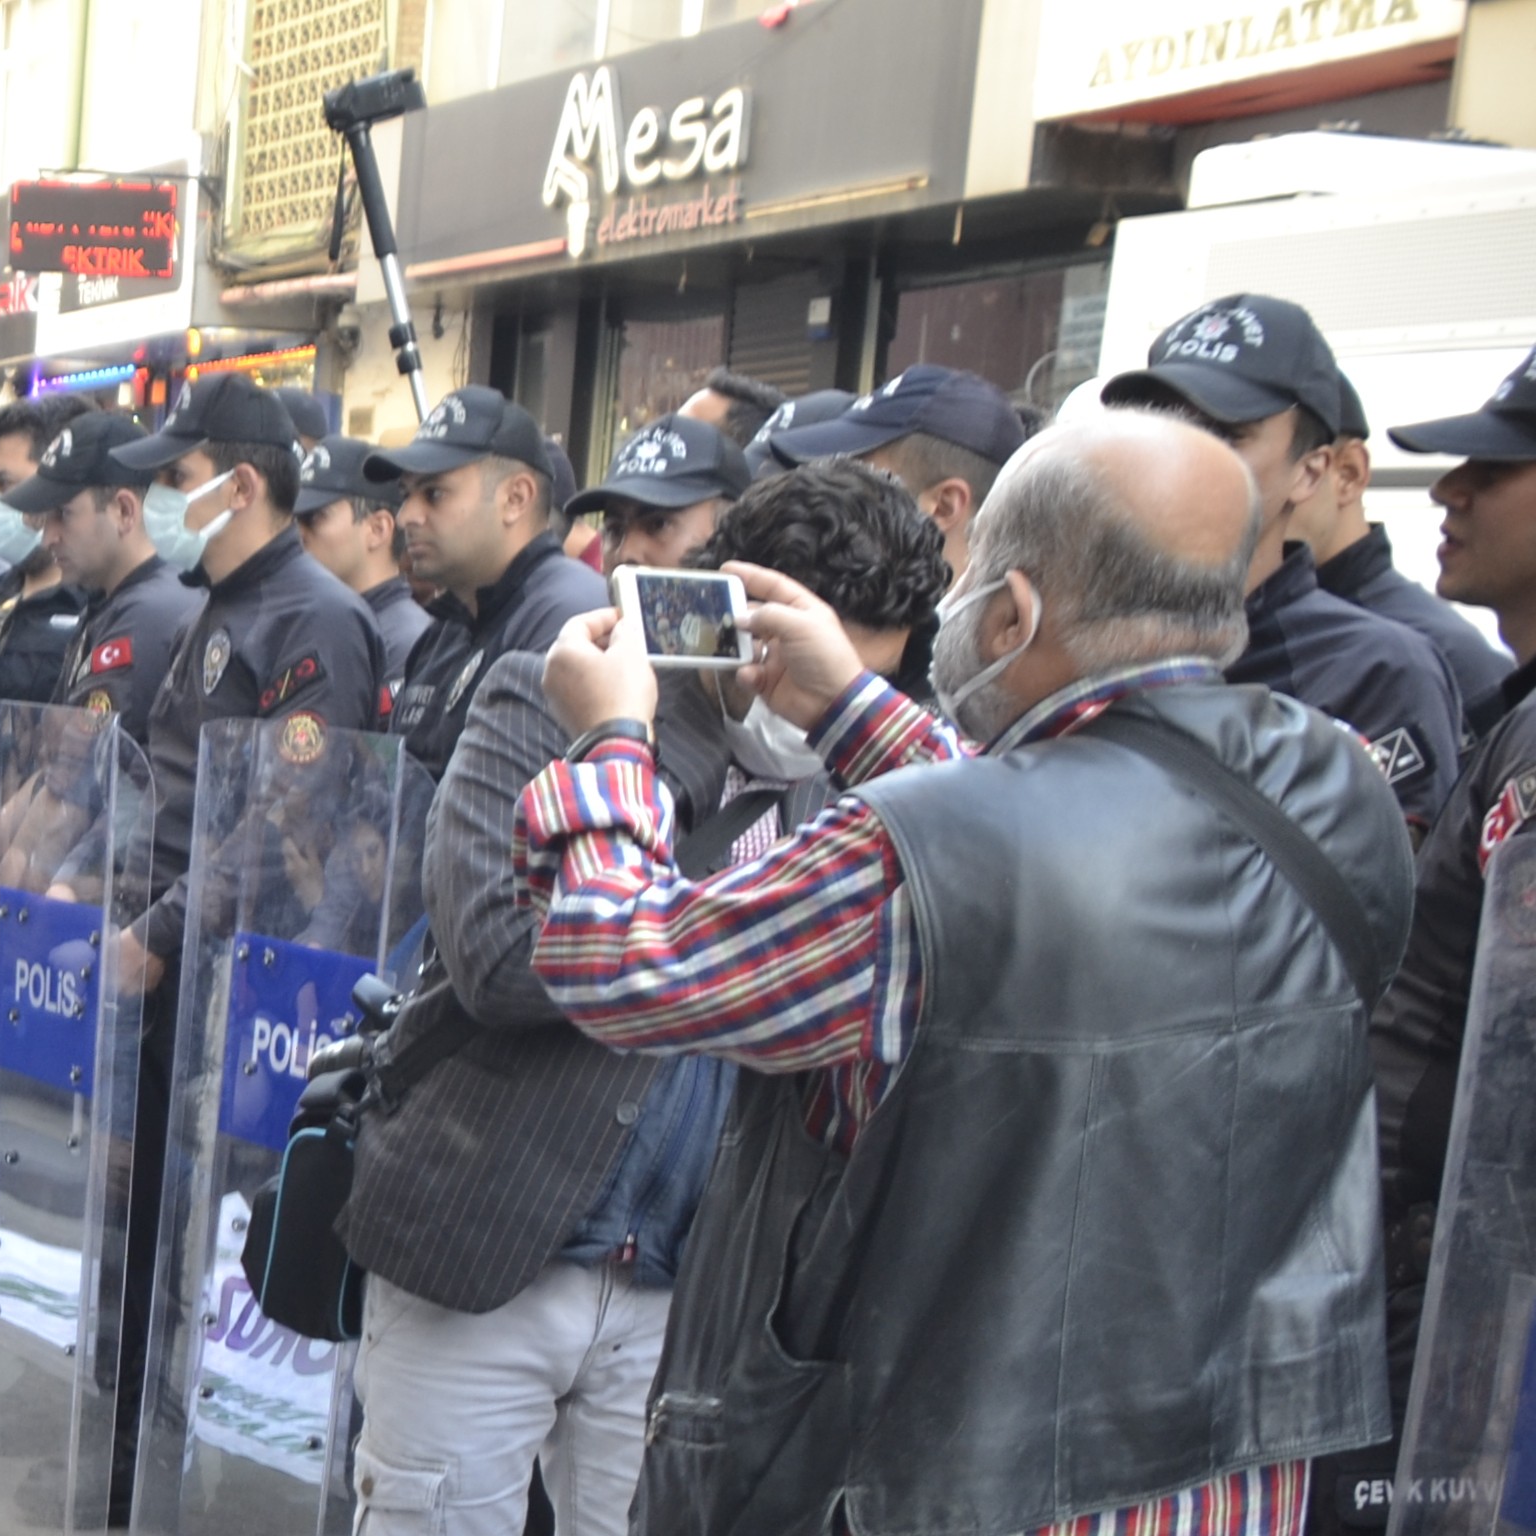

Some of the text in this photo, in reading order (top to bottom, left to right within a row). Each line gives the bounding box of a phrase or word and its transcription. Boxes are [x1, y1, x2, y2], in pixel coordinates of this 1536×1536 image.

[1088, 0, 1419, 88] AYDINLATMA
[542, 66, 752, 206] Mesa
[597, 180, 740, 243] elektromarket
[15, 958, 77, 1019] POLİS
